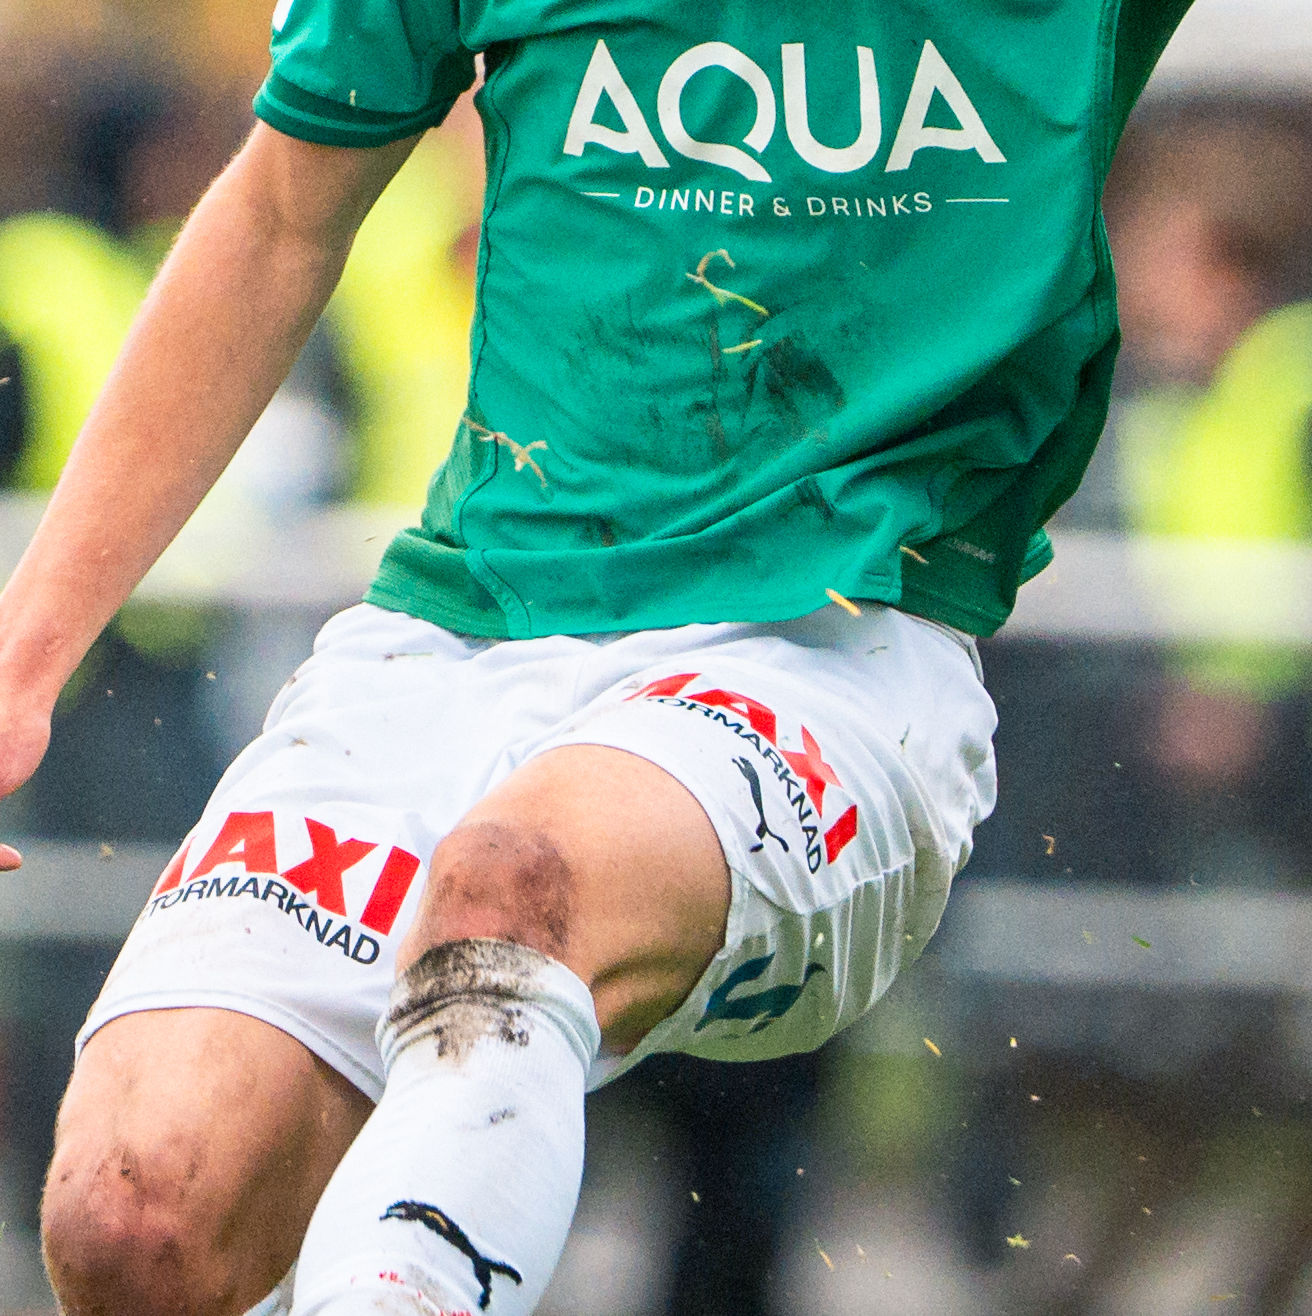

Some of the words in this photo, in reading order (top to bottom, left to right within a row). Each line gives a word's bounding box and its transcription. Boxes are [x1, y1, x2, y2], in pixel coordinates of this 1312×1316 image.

[563, 39, 1007, 183] AQUA
[634, 186, 755, 217] DINNER
[773, 197, 791, 217] &
[806, 192, 933, 217] DRINKS
[144, 876, 380, 965] TORMARKNAD
[156, 810, 421, 937] AXI
